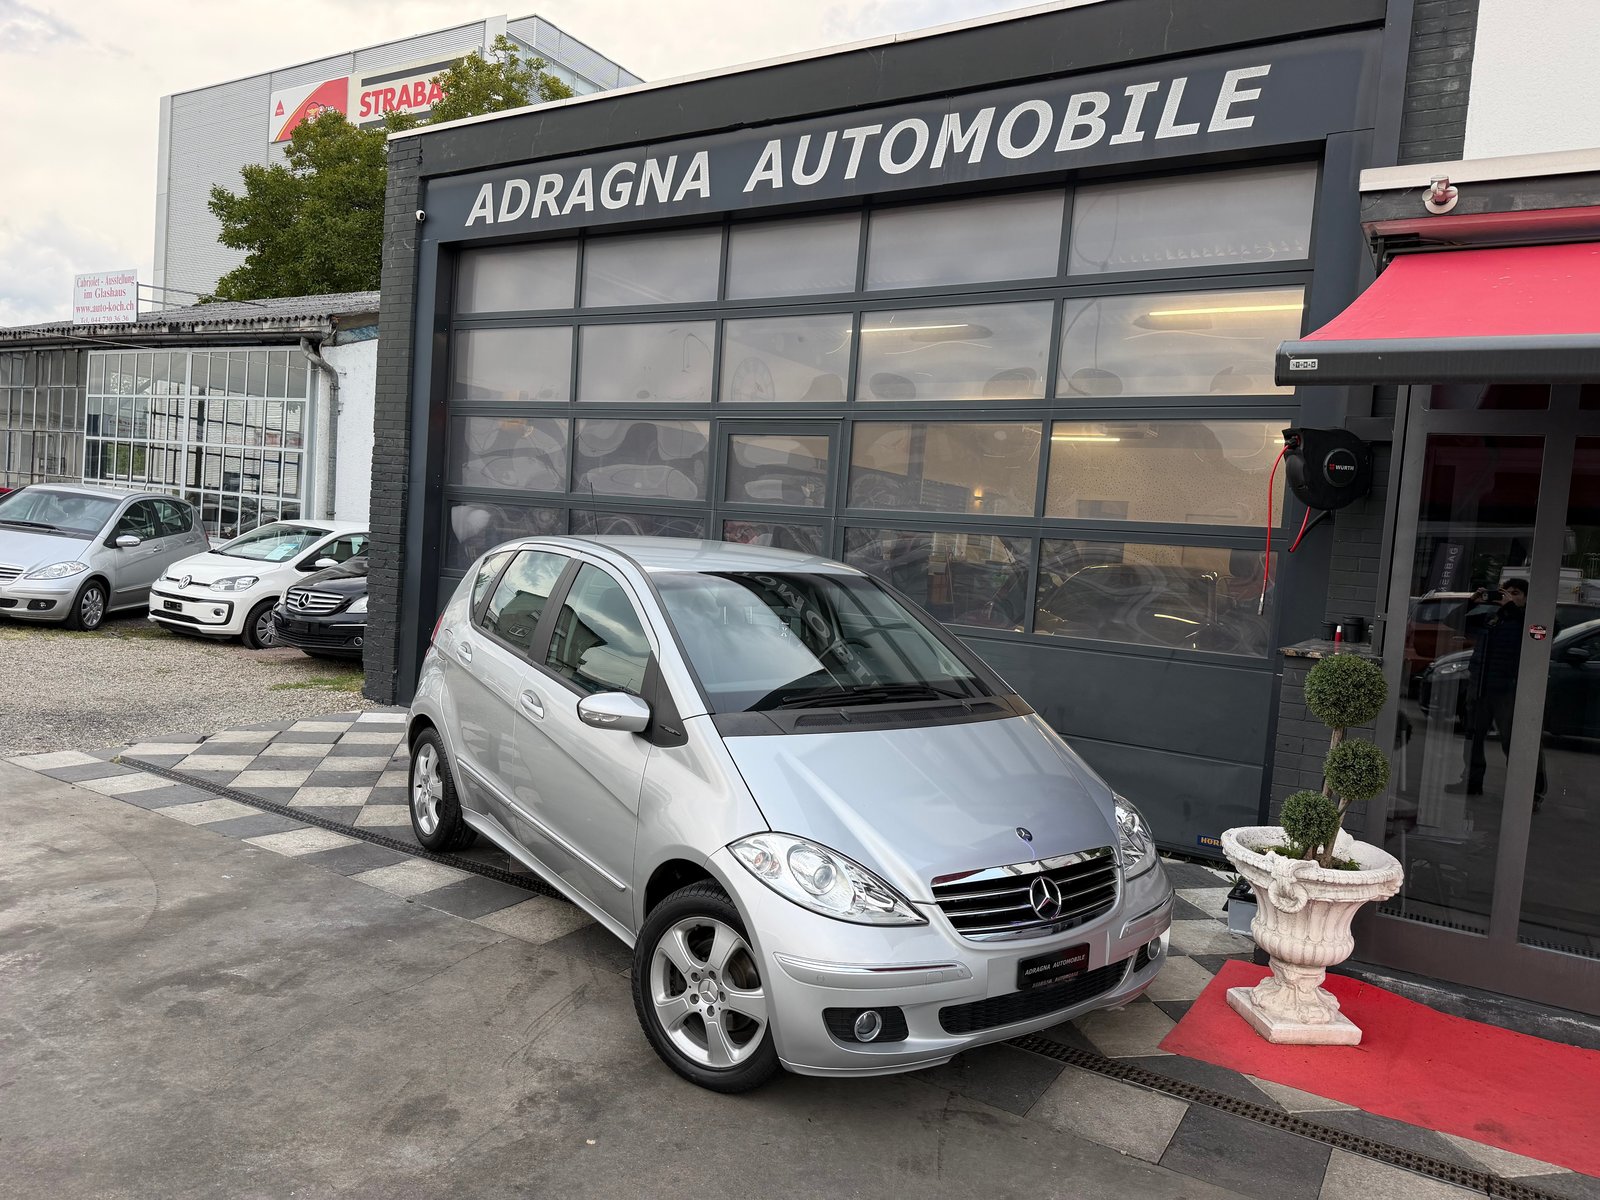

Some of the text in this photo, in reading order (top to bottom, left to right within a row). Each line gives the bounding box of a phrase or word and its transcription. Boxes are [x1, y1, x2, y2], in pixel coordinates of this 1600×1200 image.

[359, 81, 448, 117] STRABA
[465, 64, 1272, 227] ADRAGNA AUTOMOBILE
[77, 276, 100, 288] Cabriolet
[105, 274, 135, 286] Ausstellung
[84, 287, 127, 299] im Glashaus
[76, 300, 134, 312] www.auto-koch.ch
[1025, 954, 1086, 976] ADRAGNA AUTOMOBILE
